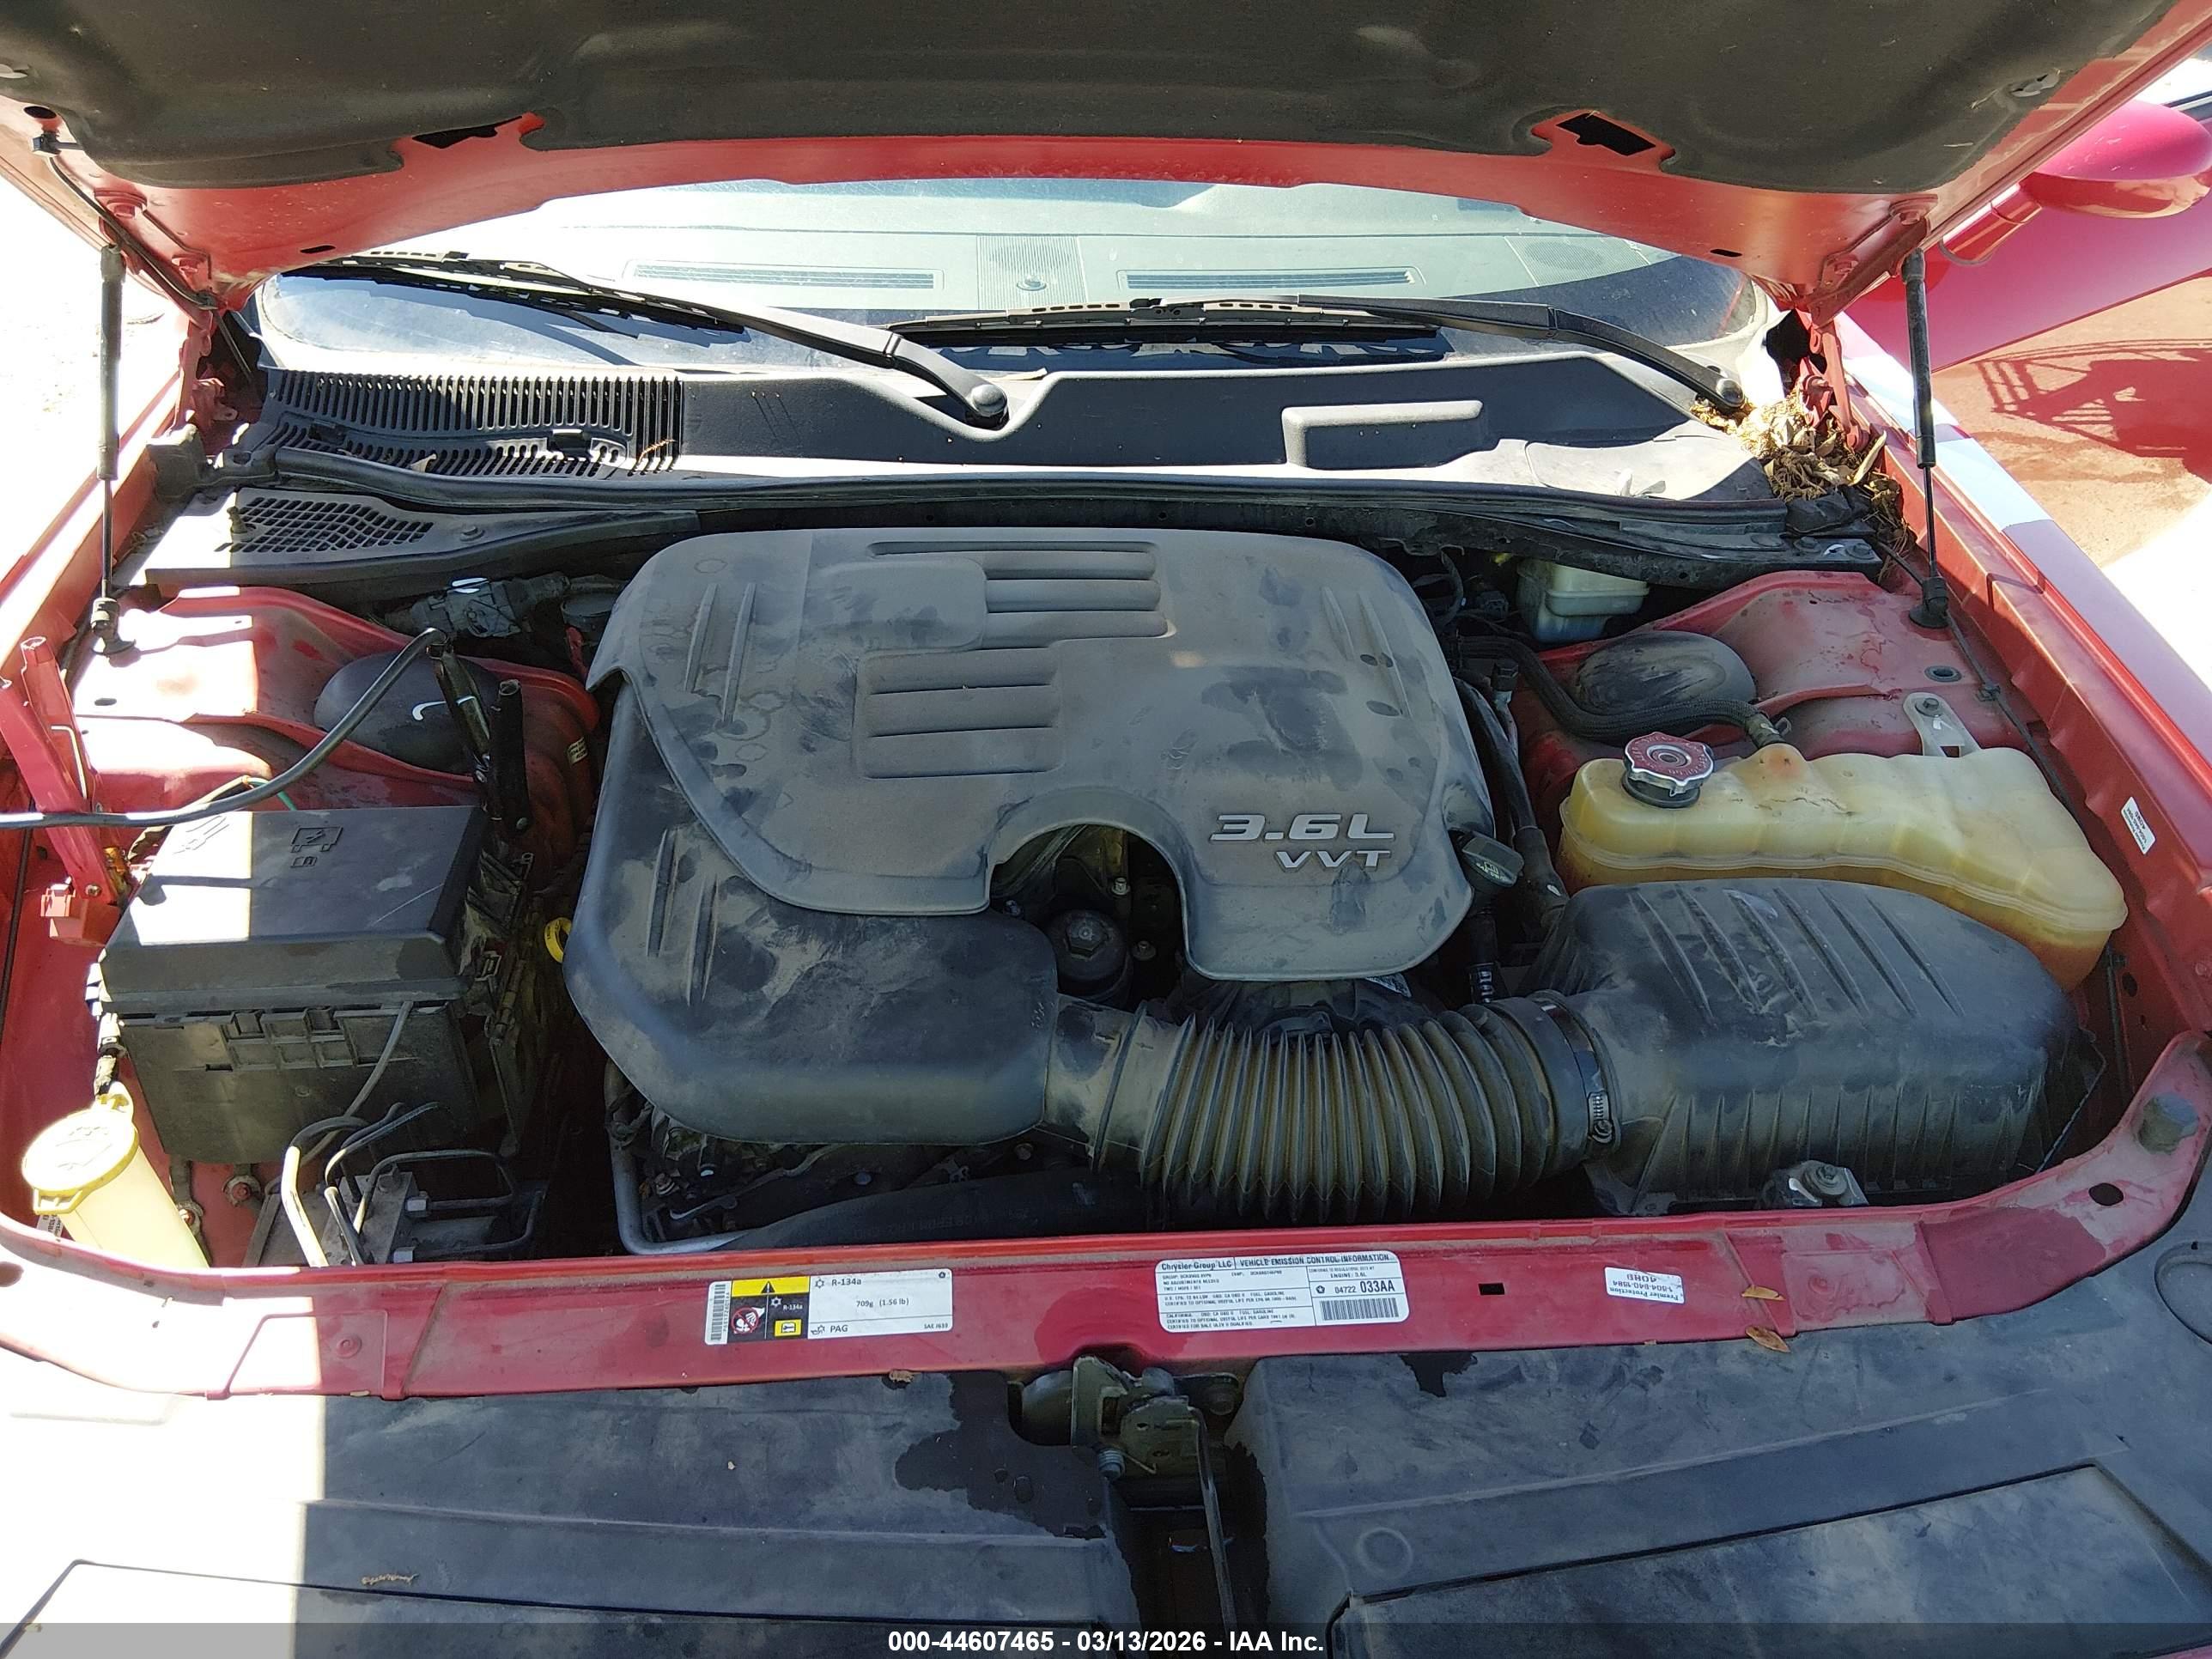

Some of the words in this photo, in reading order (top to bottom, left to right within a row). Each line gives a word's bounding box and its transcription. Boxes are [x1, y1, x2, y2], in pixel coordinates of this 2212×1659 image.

[1210, 814, 1395, 841] 3.6L
[1275, 850, 1391, 868] VVT
[1194, 1261, 1216, 1271] Group
[1218, 1260, 1231, 1268] LLC
[1271, 1257, 1304, 1266] EMISSION
[1306, 1255, 1337, 1265] CONTROL
[1340, 1255, 1389, 1264] INFORMATION
[832, 1279, 862, 1287] R-134a
[1359, 1279, 1395, 1293] 033AA
[1609, 1286, 1648, 1297] Protection
[1649, 1291, 1679, 1301] Premier
[782, 1304, 804, 1312] R-134a
[856, 1300, 874, 1309] 709g
[878, 1298, 897, 1307] (1.56
[898, 1297, 909, 1306] lb)
[830, 1323, 848, 1333] PAG
